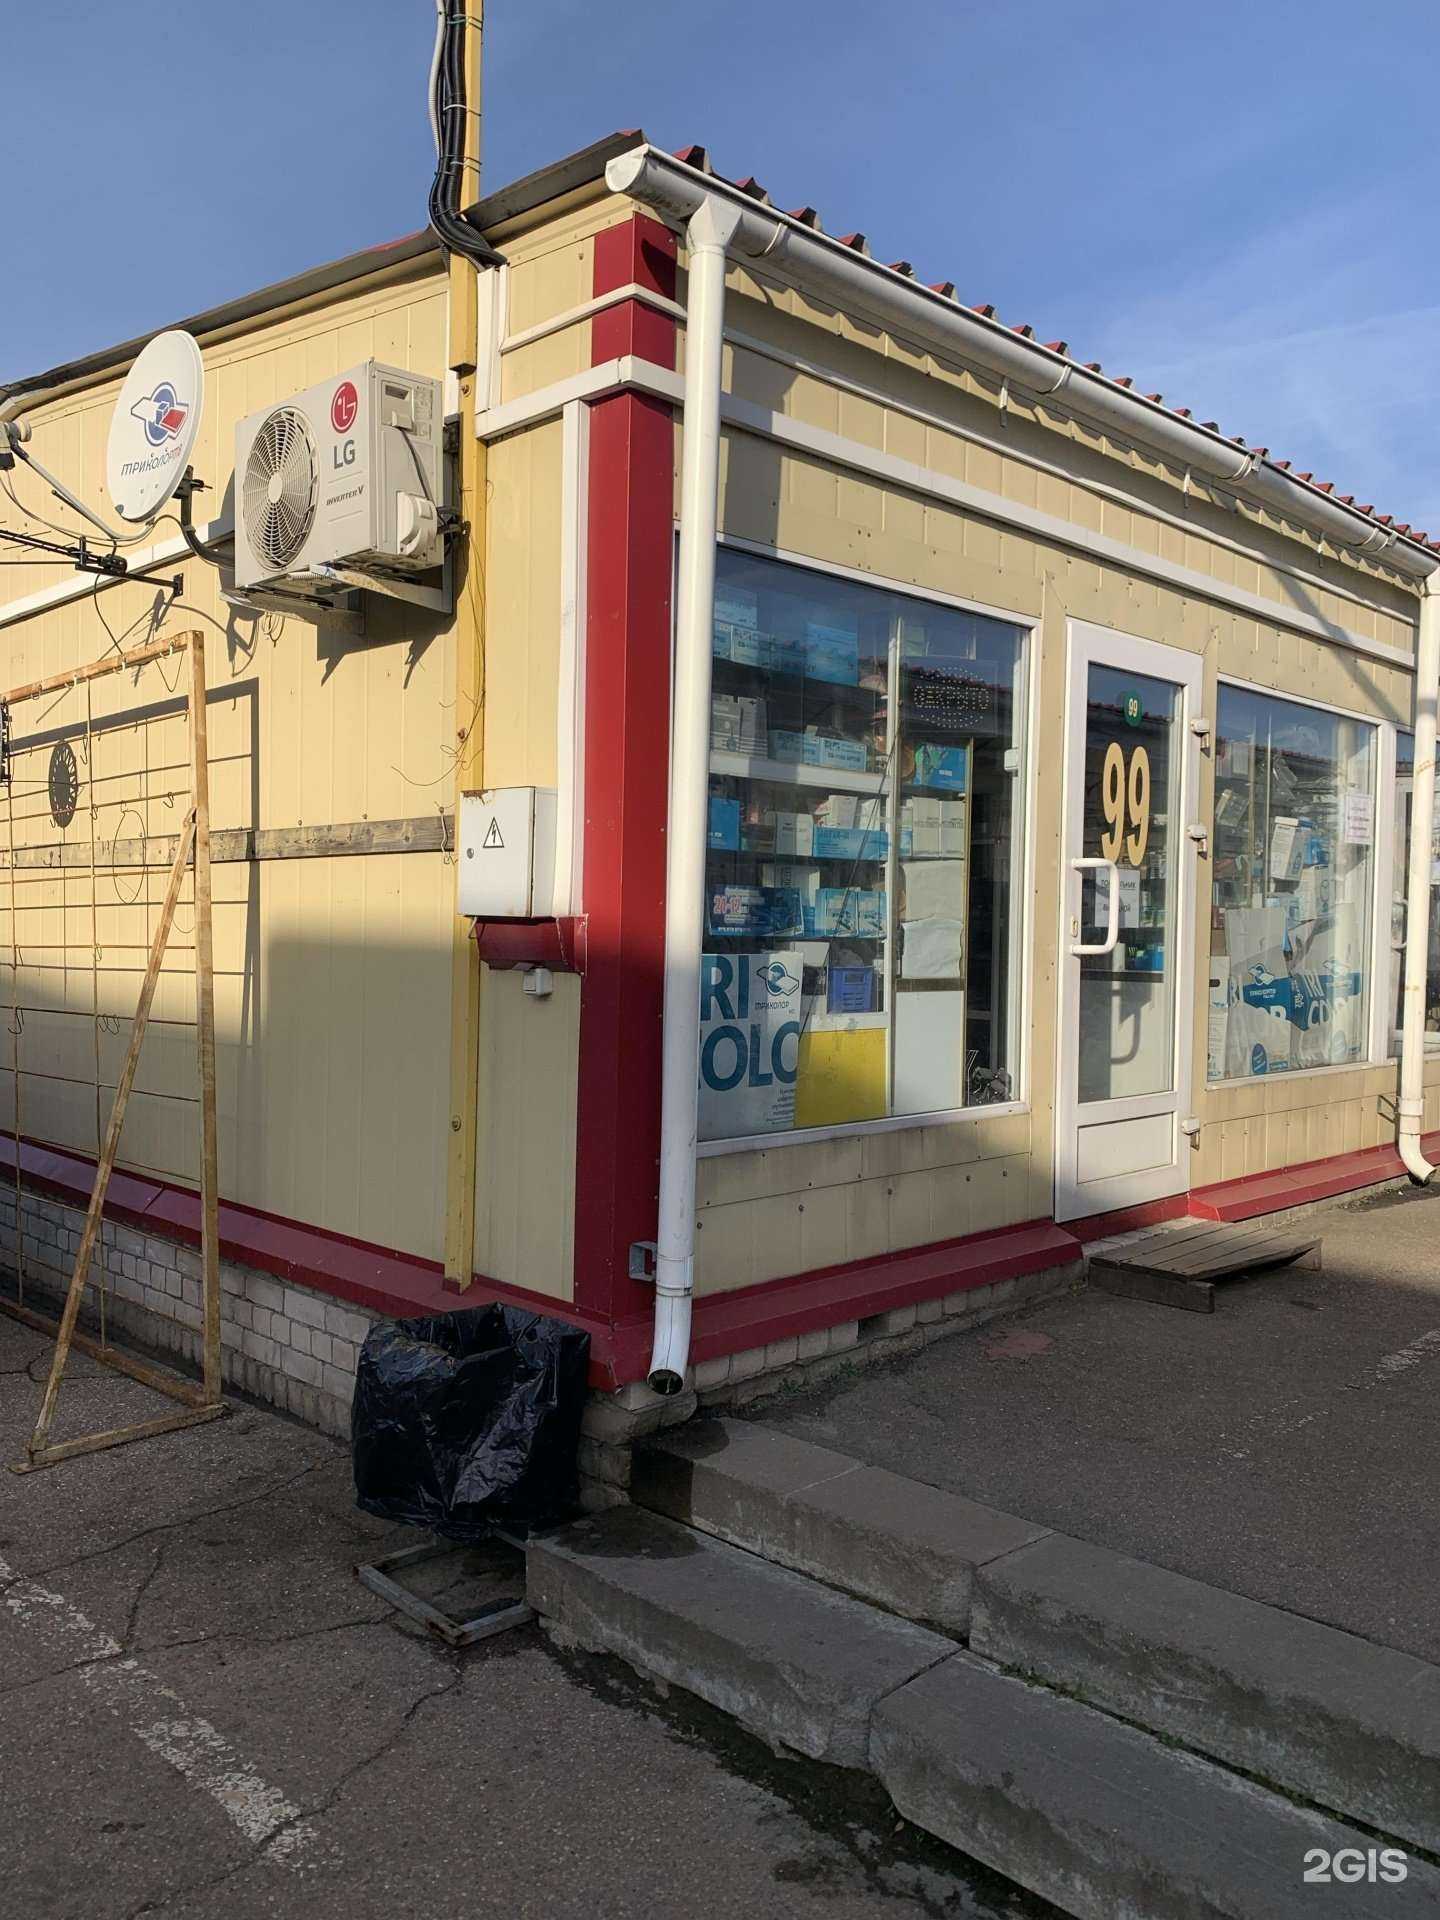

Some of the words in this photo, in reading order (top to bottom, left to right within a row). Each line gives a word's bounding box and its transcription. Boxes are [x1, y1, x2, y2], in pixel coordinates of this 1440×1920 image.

[333, 439, 355, 469] LG
[1127, 697, 1139, 718] 99
[1102, 743, 1150, 867] 99
[700, 954, 750, 1021] RI
[698, 1020, 799, 1091] OLO
